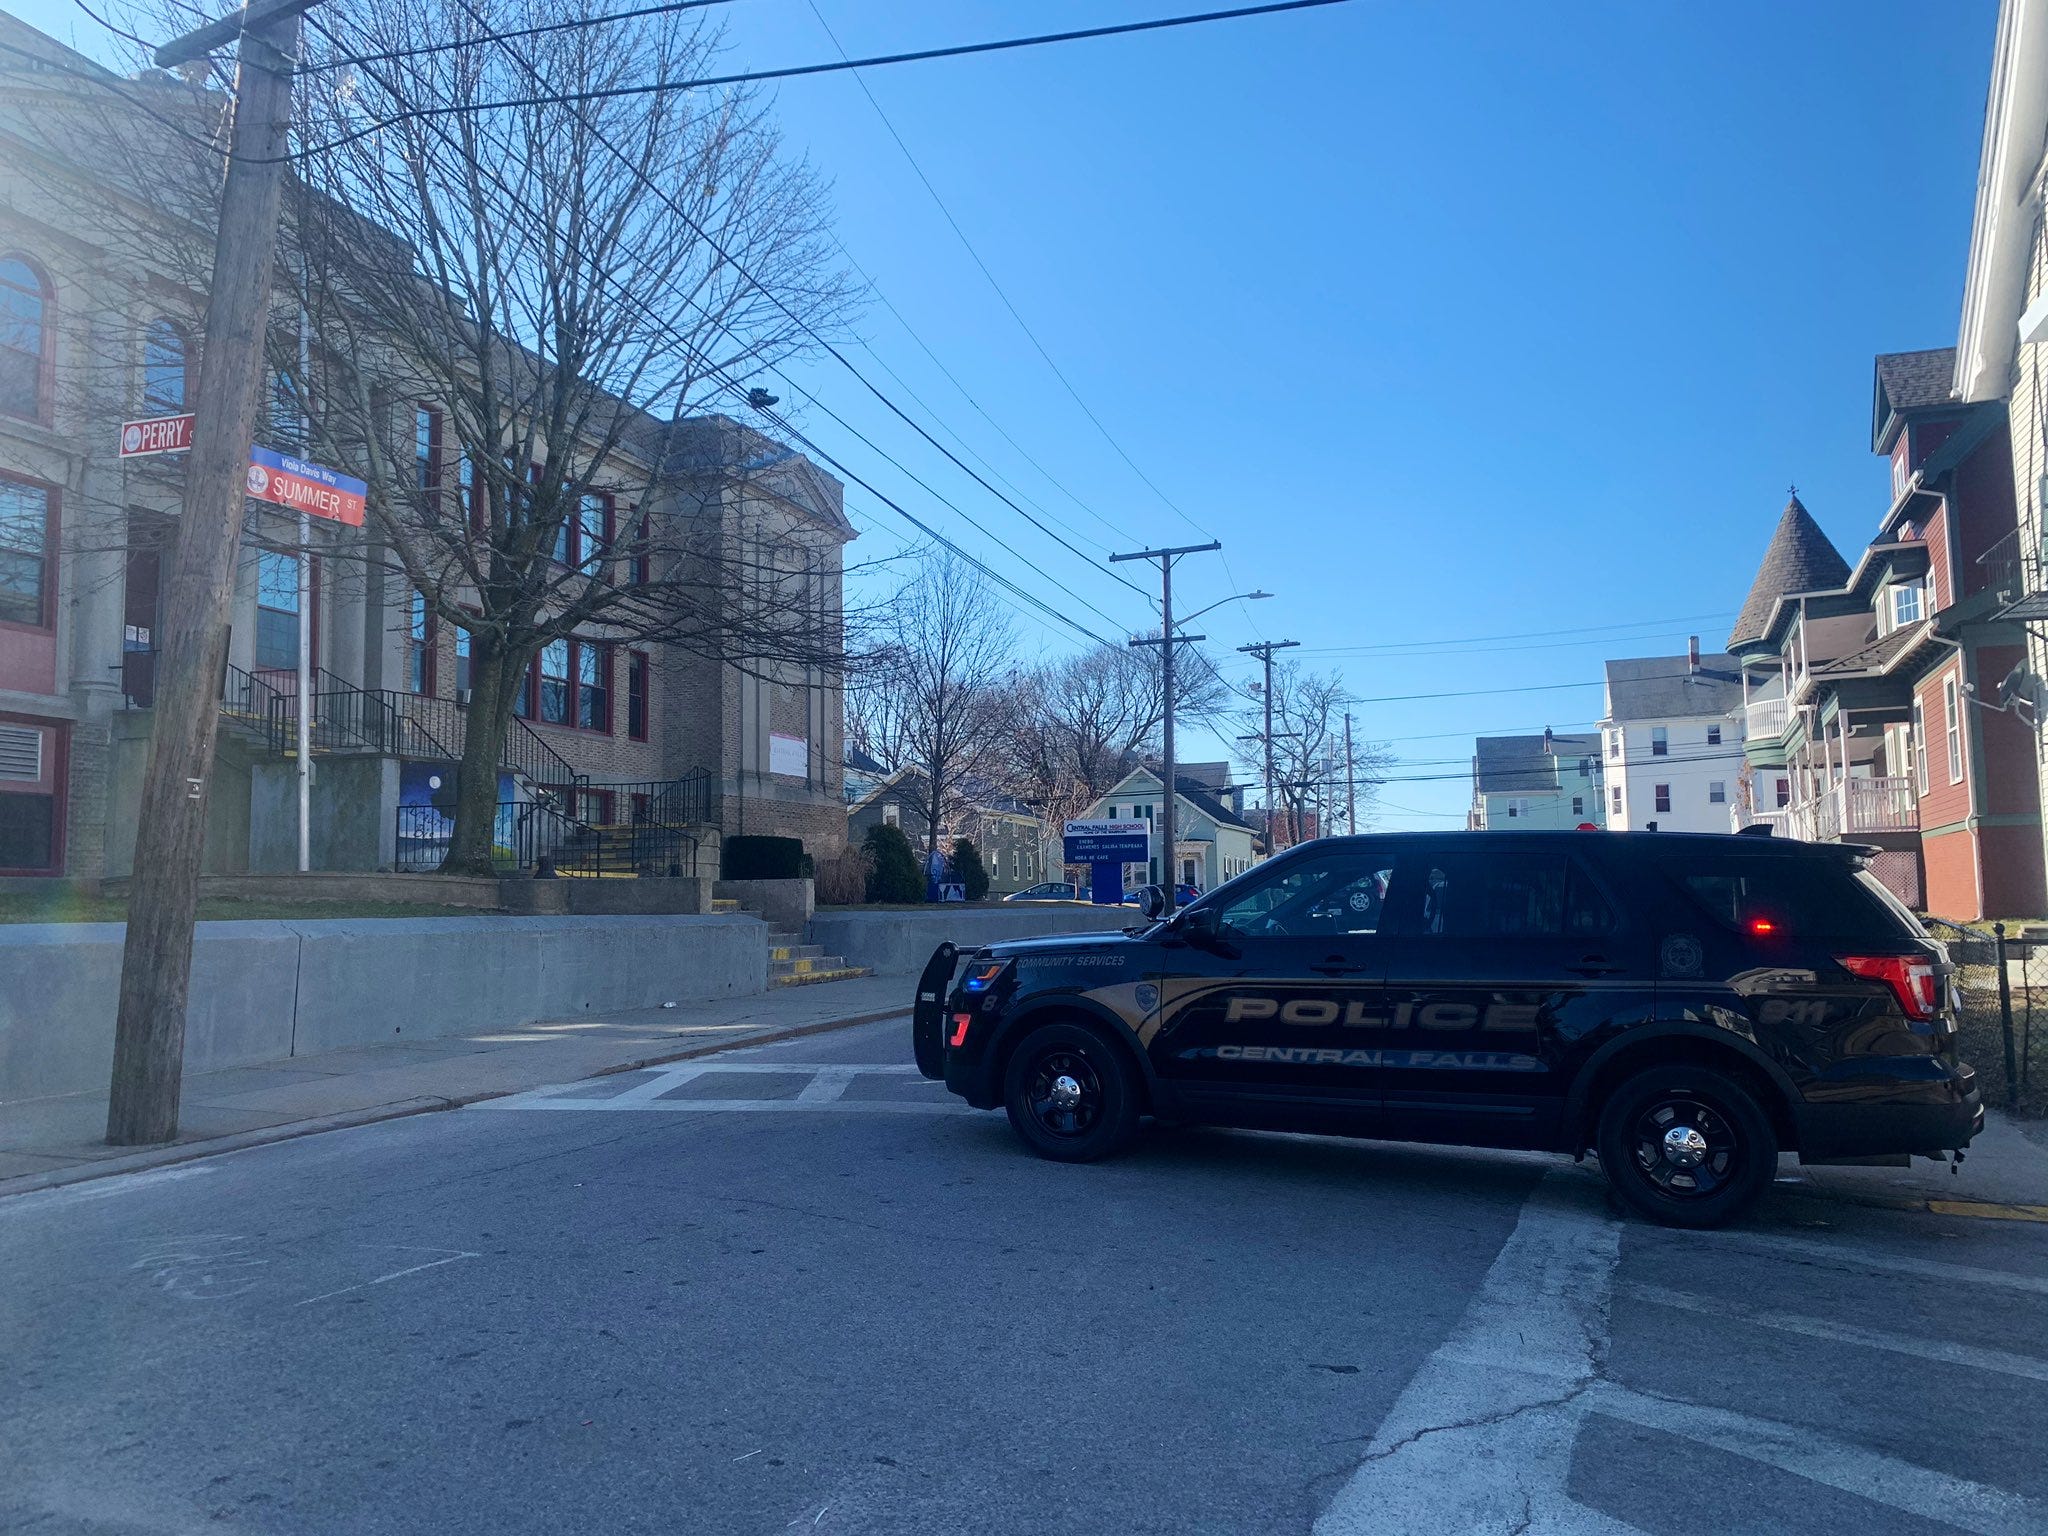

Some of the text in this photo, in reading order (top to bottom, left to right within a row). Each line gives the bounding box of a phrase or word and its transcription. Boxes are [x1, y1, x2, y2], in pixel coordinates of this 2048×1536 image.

[141, 419, 184, 450] PERRY
[281, 457, 337, 486] Viola Davis Way
[273, 476, 340, 514] SUMMER
[1016, 955, 1126, 969] COMMUNITY SERVICES
[1223, 996, 1540, 1032] POLICE
[1215, 1045, 1538, 1070] CENTRAL FALLS
